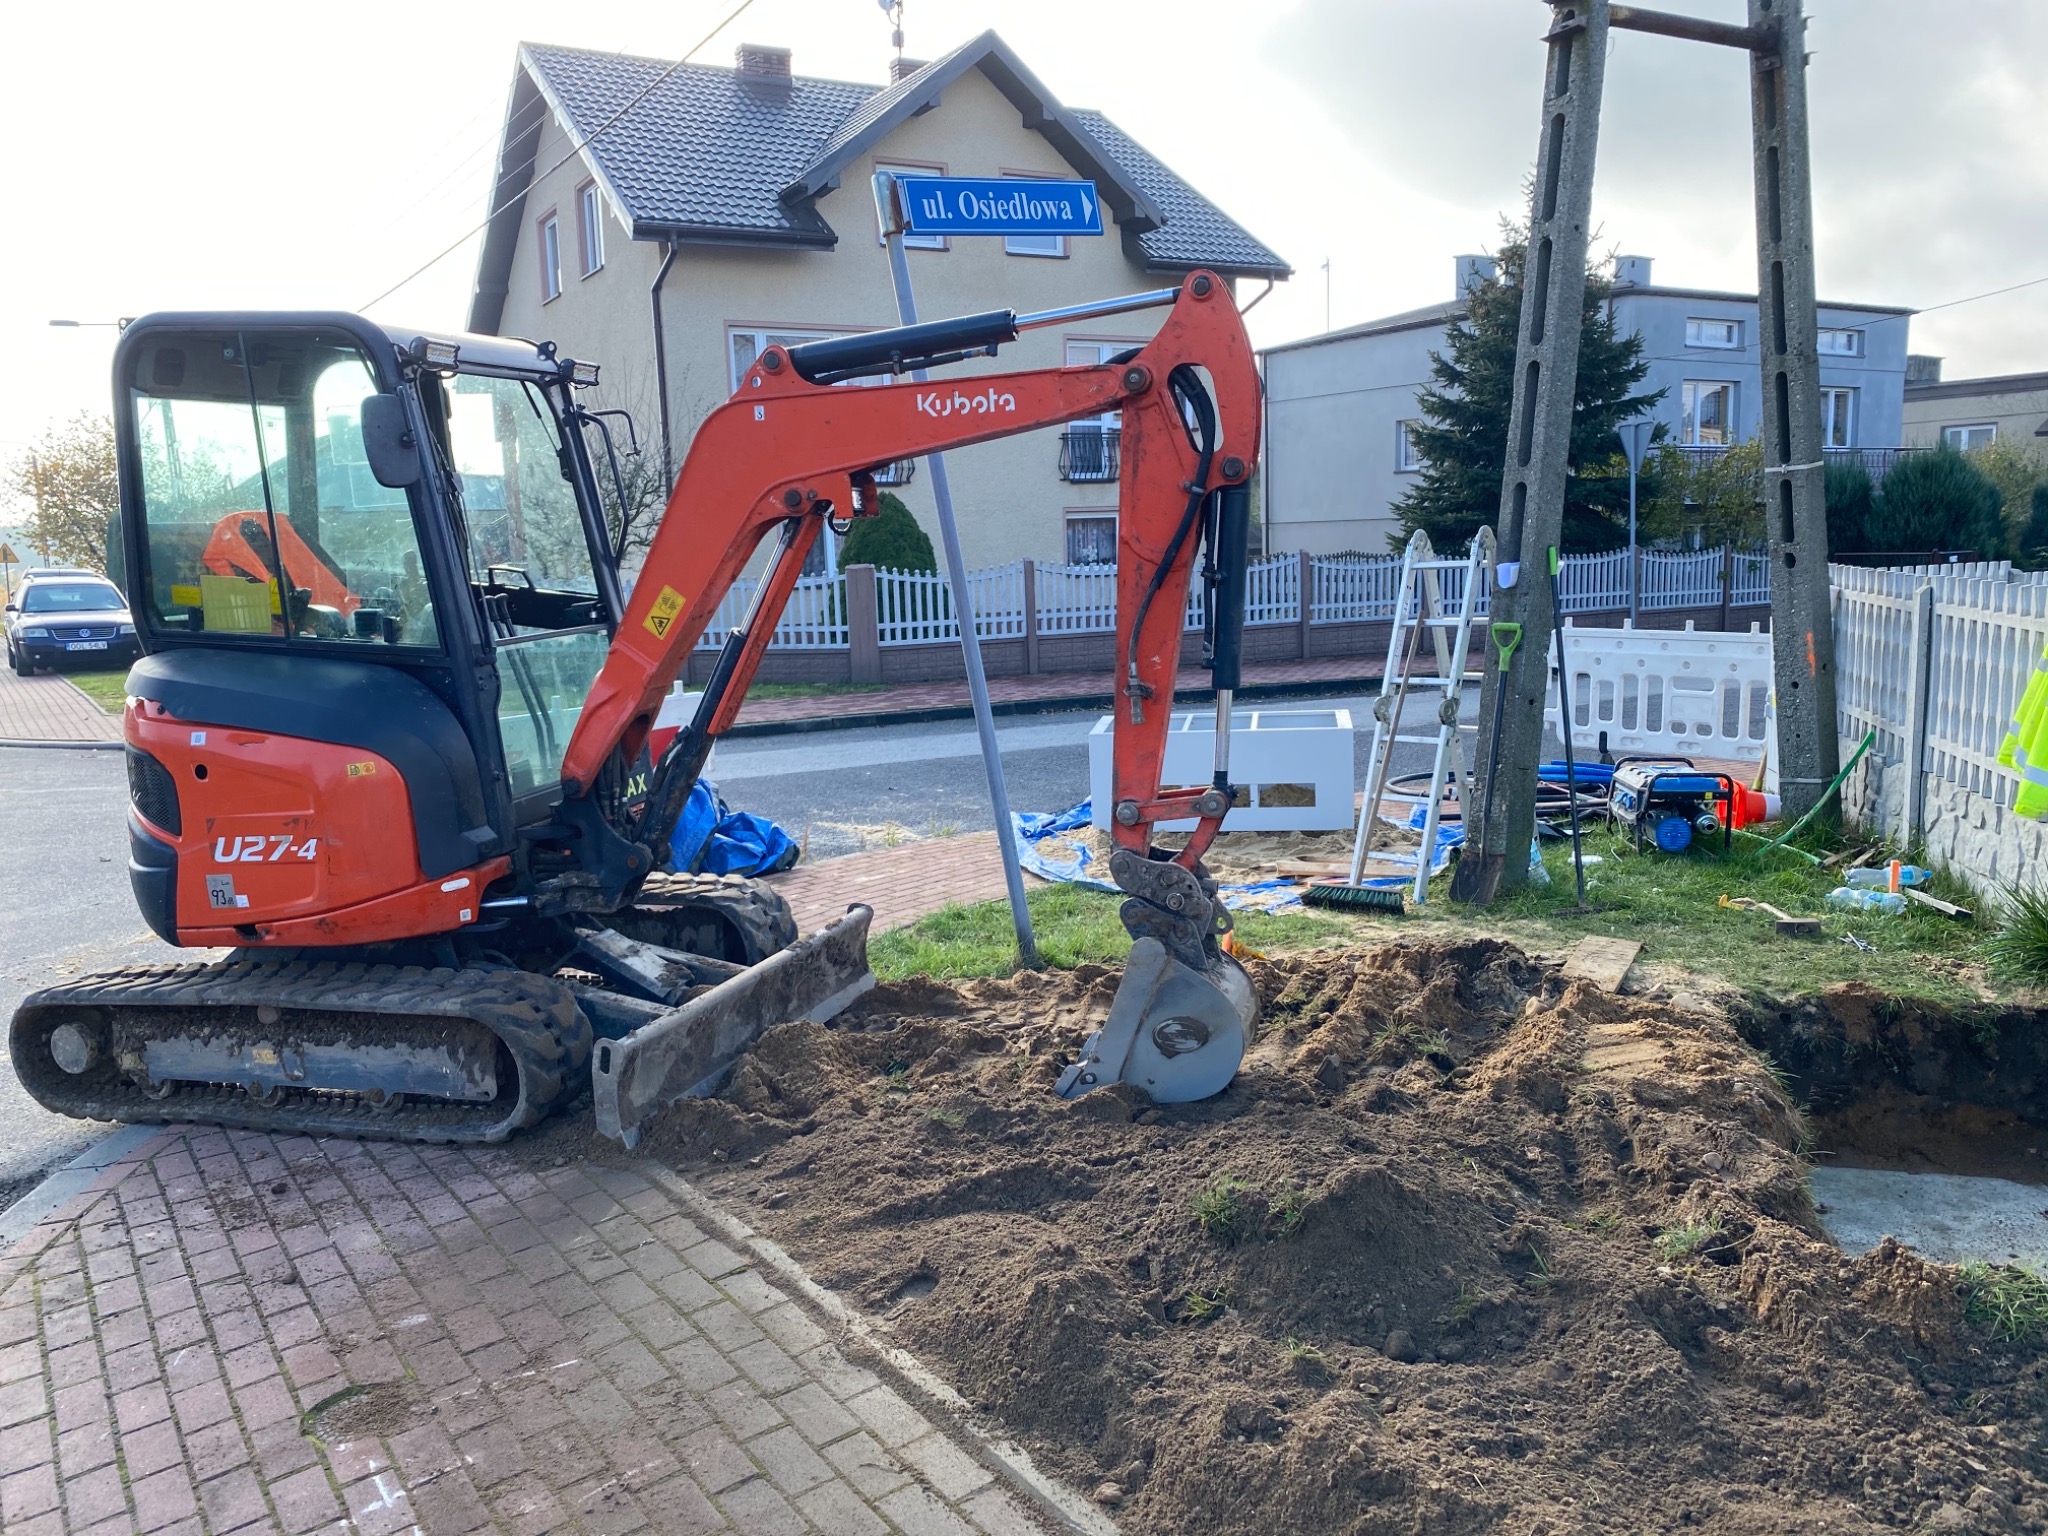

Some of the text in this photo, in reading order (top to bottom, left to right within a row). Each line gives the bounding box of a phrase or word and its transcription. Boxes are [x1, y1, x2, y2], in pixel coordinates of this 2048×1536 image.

[921, 190, 1073, 221] ul. Osiedlowa
[916, 387, 1016, 417] Kubota
[214, 834, 318, 863] U27-4
